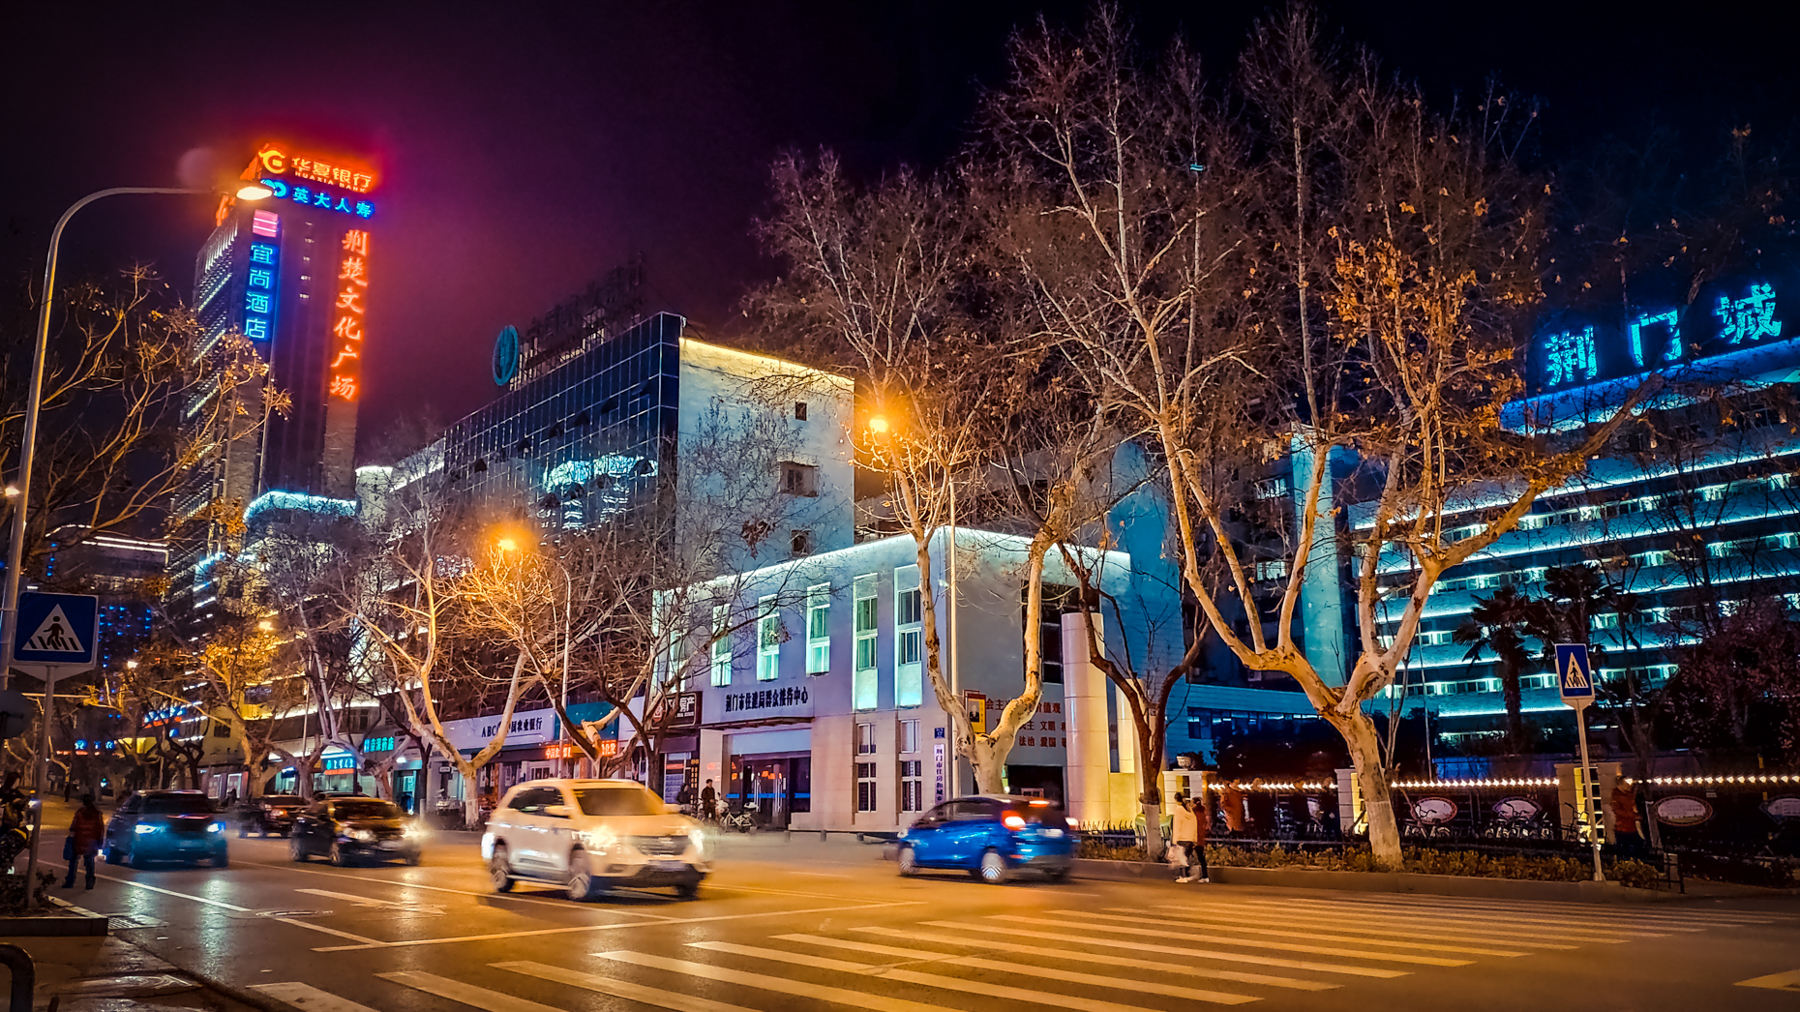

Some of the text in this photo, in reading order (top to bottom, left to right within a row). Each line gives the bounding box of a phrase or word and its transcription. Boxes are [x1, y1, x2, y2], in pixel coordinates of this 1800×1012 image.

[291, 158, 371, 188] 华夏银行
[293, 187, 371, 218] 英大人寿
[294, 171, 366, 193] HUAXIA BANK
[244, 244, 273, 339] 宜尚酒店
[330, 230, 369, 400] 荆楚文化广场
[1545, 283, 1782, 386] 荆门城
